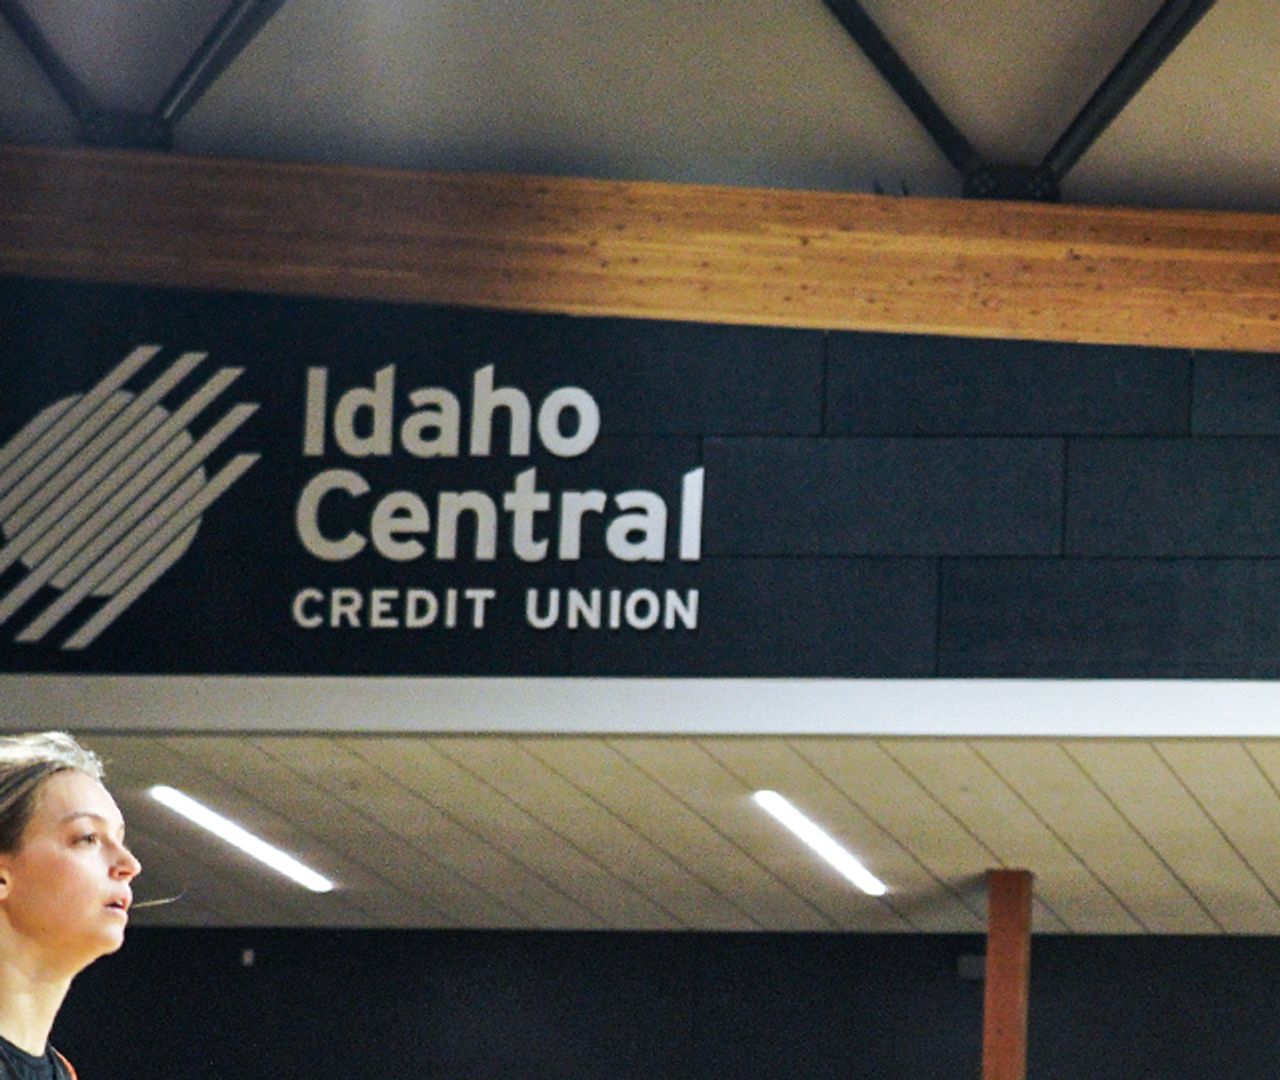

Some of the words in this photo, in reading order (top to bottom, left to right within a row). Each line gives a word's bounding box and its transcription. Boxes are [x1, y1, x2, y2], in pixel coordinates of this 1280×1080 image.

[304, 363, 601, 458] Idaho
[294, 467, 705, 563] Central
[291, 587, 497, 630] CREDIT
[526, 588, 699, 631] UNION
